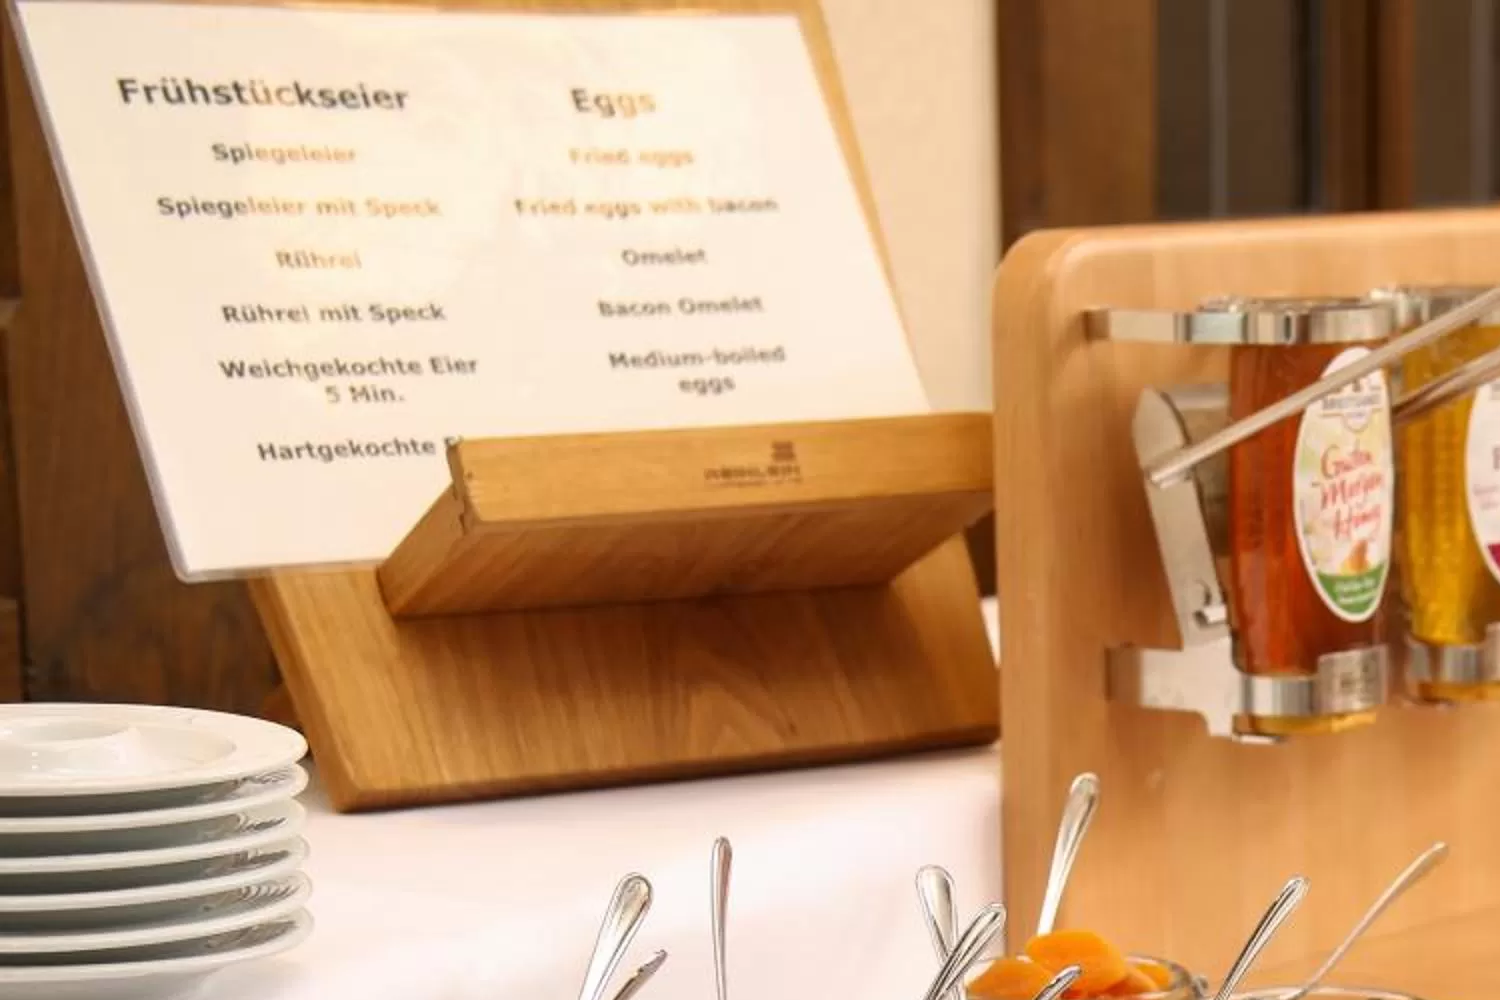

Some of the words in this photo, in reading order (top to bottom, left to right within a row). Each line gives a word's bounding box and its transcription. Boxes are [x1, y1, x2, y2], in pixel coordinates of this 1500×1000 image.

[116, 77, 410, 110] Frühstückseier
[571, 88, 656, 119] Eggs
[211, 143, 356, 165] Spiegeleier
[569, 149, 630, 165] Fried
[639, 150, 694, 168] eggs
[157, 196, 306, 219] Spiegeleier
[316, 198, 356, 216] mit
[365, 198, 441, 219] Speck
[514, 198, 577, 216] Fried
[584, 200, 642, 219] eggs
[650, 196, 701, 214] with
[707, 197, 779, 213] bacon
[275, 249, 362, 270] Rührei
[621, 246, 708, 266] Omelet
[221, 303, 310, 324] Rührei
[319, 304, 363, 322] mit
[368, 302, 448, 326] Speck
[597, 299, 673, 317] Bacon
[677, 296, 765, 315] Omelet
[218, 356, 424, 382] Weichgekochte
[428, 355, 479, 375] Eier
[608, 345, 787, 369] Medium-boiled
[325, 385, 342, 404] 5
[348, 385, 406, 404] Min.
[677, 375, 737, 397] eggs
[257, 437, 437, 462] Hartgekochte
